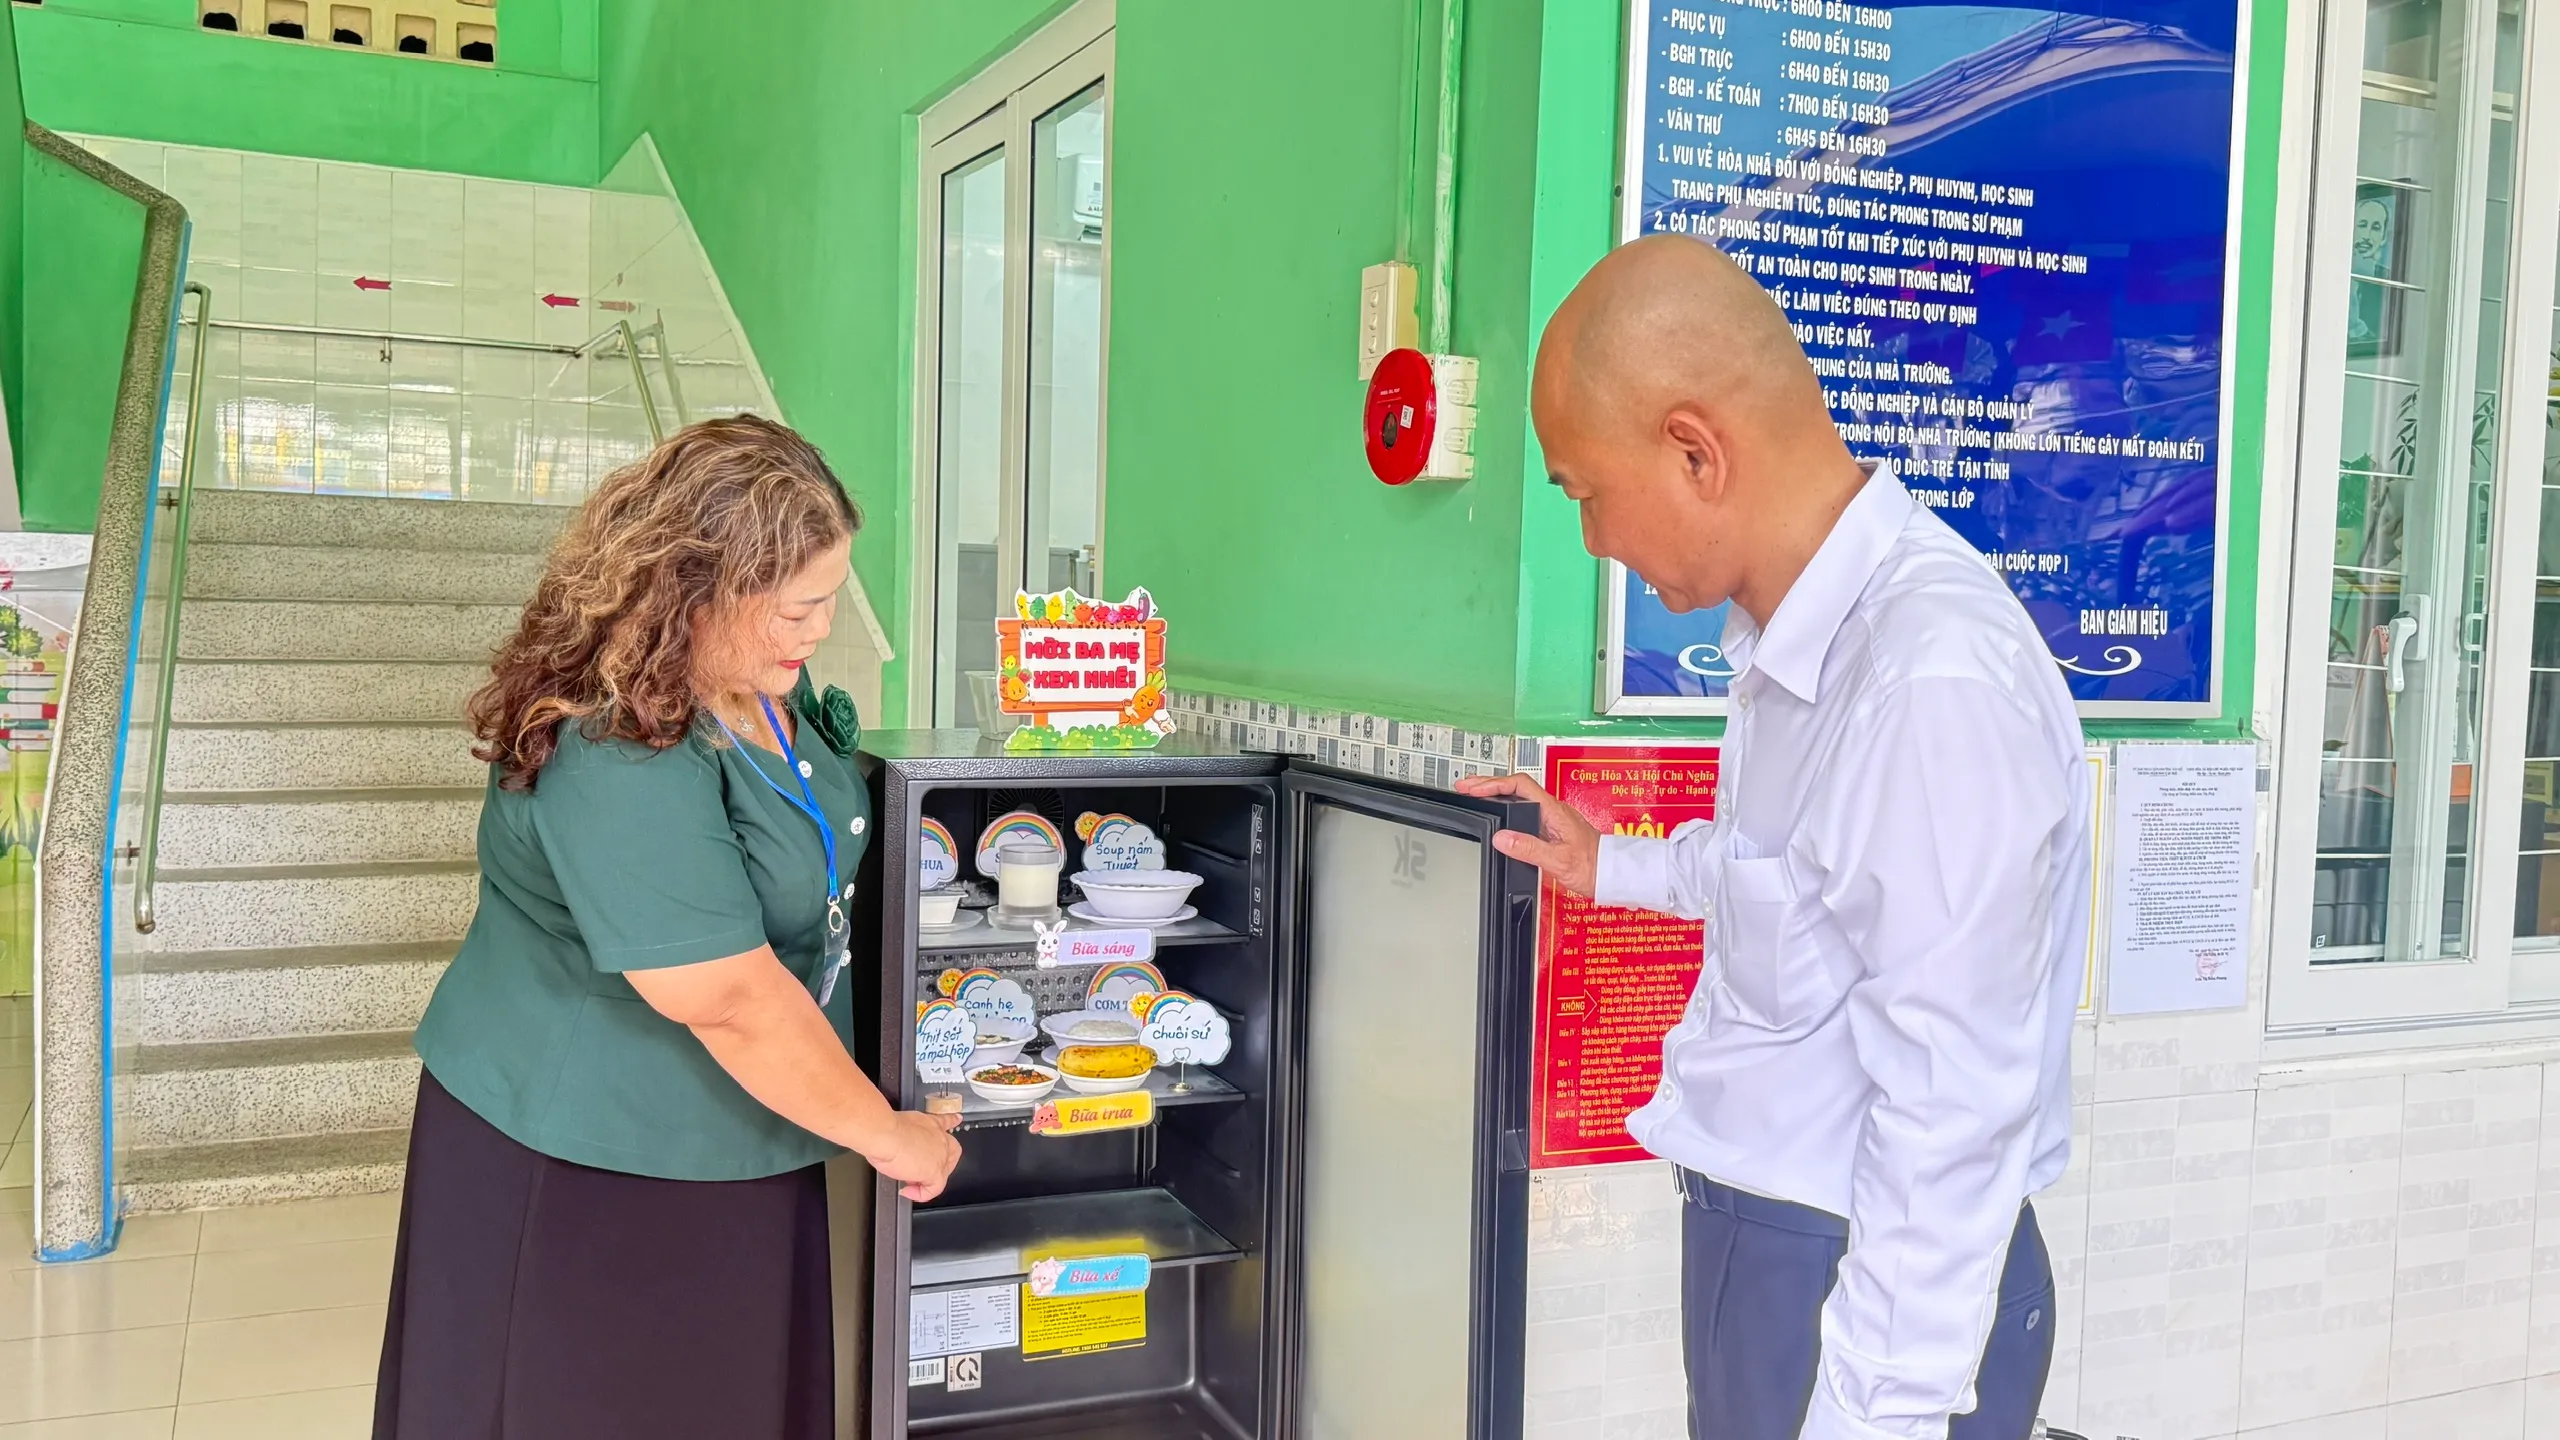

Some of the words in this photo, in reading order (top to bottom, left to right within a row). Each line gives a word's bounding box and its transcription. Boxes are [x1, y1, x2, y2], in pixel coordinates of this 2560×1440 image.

[1854, 6, 1892, 30] 16H00
[1671, 8, 1706, 36] PHỤC
[1710, 15, 1726, 39] VỤ
[1790, 29, 1821, 51] 6H00
[1824, 29, 1850, 56] ĐẾN
[1854, 39, 1890, 62] 15H30
[1670, 42, 1696, 64] BGH
[1700, 48, 1733, 72] TRỰC
[1788, 62, 1820, 83] 6H40
[1824, 61, 1848, 88] ĐẾN
[1852, 71, 1890, 93] 16H30
[1668, 76, 1694, 98] BGH
[1706, 76, 1726, 102] KẾ
[1727, 82, 1761, 107] TOÁN
[1788, 94, 1819, 116] 7H00
[1822, 94, 1848, 120] ĐẾN
[1852, 102, 1888, 126] 16H30
[1667, 107, 1692, 132] VĂN
[1696, 114, 1723, 135] THƯ
[1785, 129, 1816, 148] 6H45
[1820, 126, 1845, 152] ĐẾN
[1848, 135, 1886, 158] 16H30
[1658, 144, 1668, 162] 1.
[1673, 144, 1694, 165] VUI
[1697, 142, 1713, 168] VẺ
[1718, 147, 1742, 173] HÒA
[1746, 151, 1771, 176] NHÃ
[1776, 150, 1796, 179] ĐỐI
[1800, 157, 1820, 182] VỚI
[1824, 158, 1856, 187] ĐỒNG
[1860, 166, 1906, 196] NGHIỆP,
[1909, 175, 1933, 199] PHỤ
[1936, 178, 1978, 204] HUYNH,
[1982, 184, 2004, 206] HỌC
[2008, 187, 2034, 208] SINH
[1672, 179, 1714, 203] TRANG
[1717, 185, 1742, 209] PHỤ
[1746, 186, 1794, 211] NGHIÊM
[1797, 189, 1824, 218] TÚC,
[1827, 192, 1860, 220] ĐÚNG
[1864, 198, 1887, 222] TÁC
[1890, 204, 1928, 226] PHONG
[1932, 209, 1969, 232] TRONG
[1972, 212, 1988, 233] SƯ
[1990, 217, 2022, 240] PHẠM
[1654, 212, 1666, 231] 2.
[1670, 210, 1688, 233] CÓ
[1691, 210, 1715, 236] TÁC
[1719, 219, 1760, 241] PHONG
[1763, 221, 1781, 243] SƯ
[1783, 225, 1818, 252] PHẠM
[1821, 223, 1844, 250] TỐT
[1848, 232, 1869, 252] KHI
[1872, 229, 1900, 256] TIẾP
[1901, 234, 1926, 258] XÚC
[1928, 237, 1948, 260] VỚI
[1951, 243, 1974, 266] PHỤ
[1977, 246, 2016, 267] HUYNH
[2018, 246, 2032, 269] VÀ
[2036, 252, 2060, 274] HỌC
[2062, 255, 2088, 274] SINH
[1757, 256, 1774, 275] AN
[1778, 252, 1810, 278] TOÀN
[1812, 260, 1838, 280] CHO
[1841, 264, 1866, 288] HỌC
[1869, 267, 1896, 287] SINH
[1899, 269, 1938, 290] TRONG
[1940, 269, 1974, 294] NGÀY.
[1793, 288, 1820, 312] LÀM
[1854, 295, 1886, 318] ĐÚNG
[1889, 300, 1920, 320] THEO
[1923, 304, 1946, 324] QUY
[1949, 306, 1977, 328] ĐỊNH
[1816, 322, 1844, 348] VIỆC
[1847, 322, 1874, 348] NẤY.
[1848, 354, 1872, 379] CỦA
[1876, 359, 1900, 382] NHÀ
[1903, 361, 1952, 384] TRƯỜNG.
[1841, 384, 1874, 411] ĐỒNG
[1877, 392, 1920, 416] NGHIỆP
[1922, 392, 1938, 415] VÀ
[1941, 393, 1965, 416] CÁN
[1968, 395, 1983, 422] BỘ
[1987, 395, 2017, 420] QUẢN
[2021, 399, 2034, 420] LÝ
[1874, 421, 1894, 446] NỘI
[1898, 423, 1914, 447] BỘ
[1918, 422, 1941, 446] NHÀ
[1945, 423, 1990, 448] TRƯỜNG
[1994, 428, 2036, 451] (KHÔNG
[2038, 432, 2060, 452] LỚN
[2064, 430, 2096, 454] TIẾNG
[2098, 434, 2118, 456] GÂY
[2122, 433, 2145, 457] MẤT
[2148, 436, 2177, 458] ĐOÀN
[2180, 436, 2204, 462] KẾT)
[1905, 458, 1928, 480] DỤC
[1932, 453, 1954, 477] TRẺ
[1958, 457, 1982, 481] TẬN
[1984, 458, 2010, 480] TÌNH
[1952, 487, 1974, 508] LỚP
[2006, 549, 2036, 574] CUỘC
[2038, 554, 2062, 575] HỌP
[2080, 609, 2104, 635] BAN
[2108, 603, 2137, 635] GIÁM
[2140, 603, 2168, 640] HIỆU
[1026, 636, 1070, 659] MỜI
[1075, 642, 1104, 659] BA
[1110, 642, 1140, 664] MẸ
[1034, 671, 1079, 688] XEM
[1084, 666, 1136, 688] NHÉ!
[1570, 770, 1598, 783] Cộng
[1601, 770, 1622, 780] Hòa
[1625, 770, 1639, 780] Xã
[1643, 770, 1660, 783] Hội
[1663, 770, 1683, 780] Chủ
[1686, 770, 1714, 783] Nghĩa
[1612, 785, 1628, 796] Độc
[1631, 785, 1644, 796] lập
[1654, 785, 1664, 797] Tự
[1668, 785, 1678, 794] do
[1686, 785, 1708, 796] Hạnh
[1128, 836, 1152, 855] nấm
[1583, 914, 1597, 923] quy
[1600, 913, 1616, 923] định
[1618, 911, 1633, 921] việc
[1636, 911, 1658, 922] phòng
[1072, 942, 1100, 956] Bữa
[1102, 941, 1136, 958] sáng
[964, 998, 993, 1010] canh
[998, 998, 1014, 1012] hẹ
[1561, 1001, 1585, 1012] KHÔNG
[1070, 1108, 1098, 1123] Bữa
[1101, 1107, 1133, 1121] trưa
[1070, 1269, 1099, 1284] Bữa
